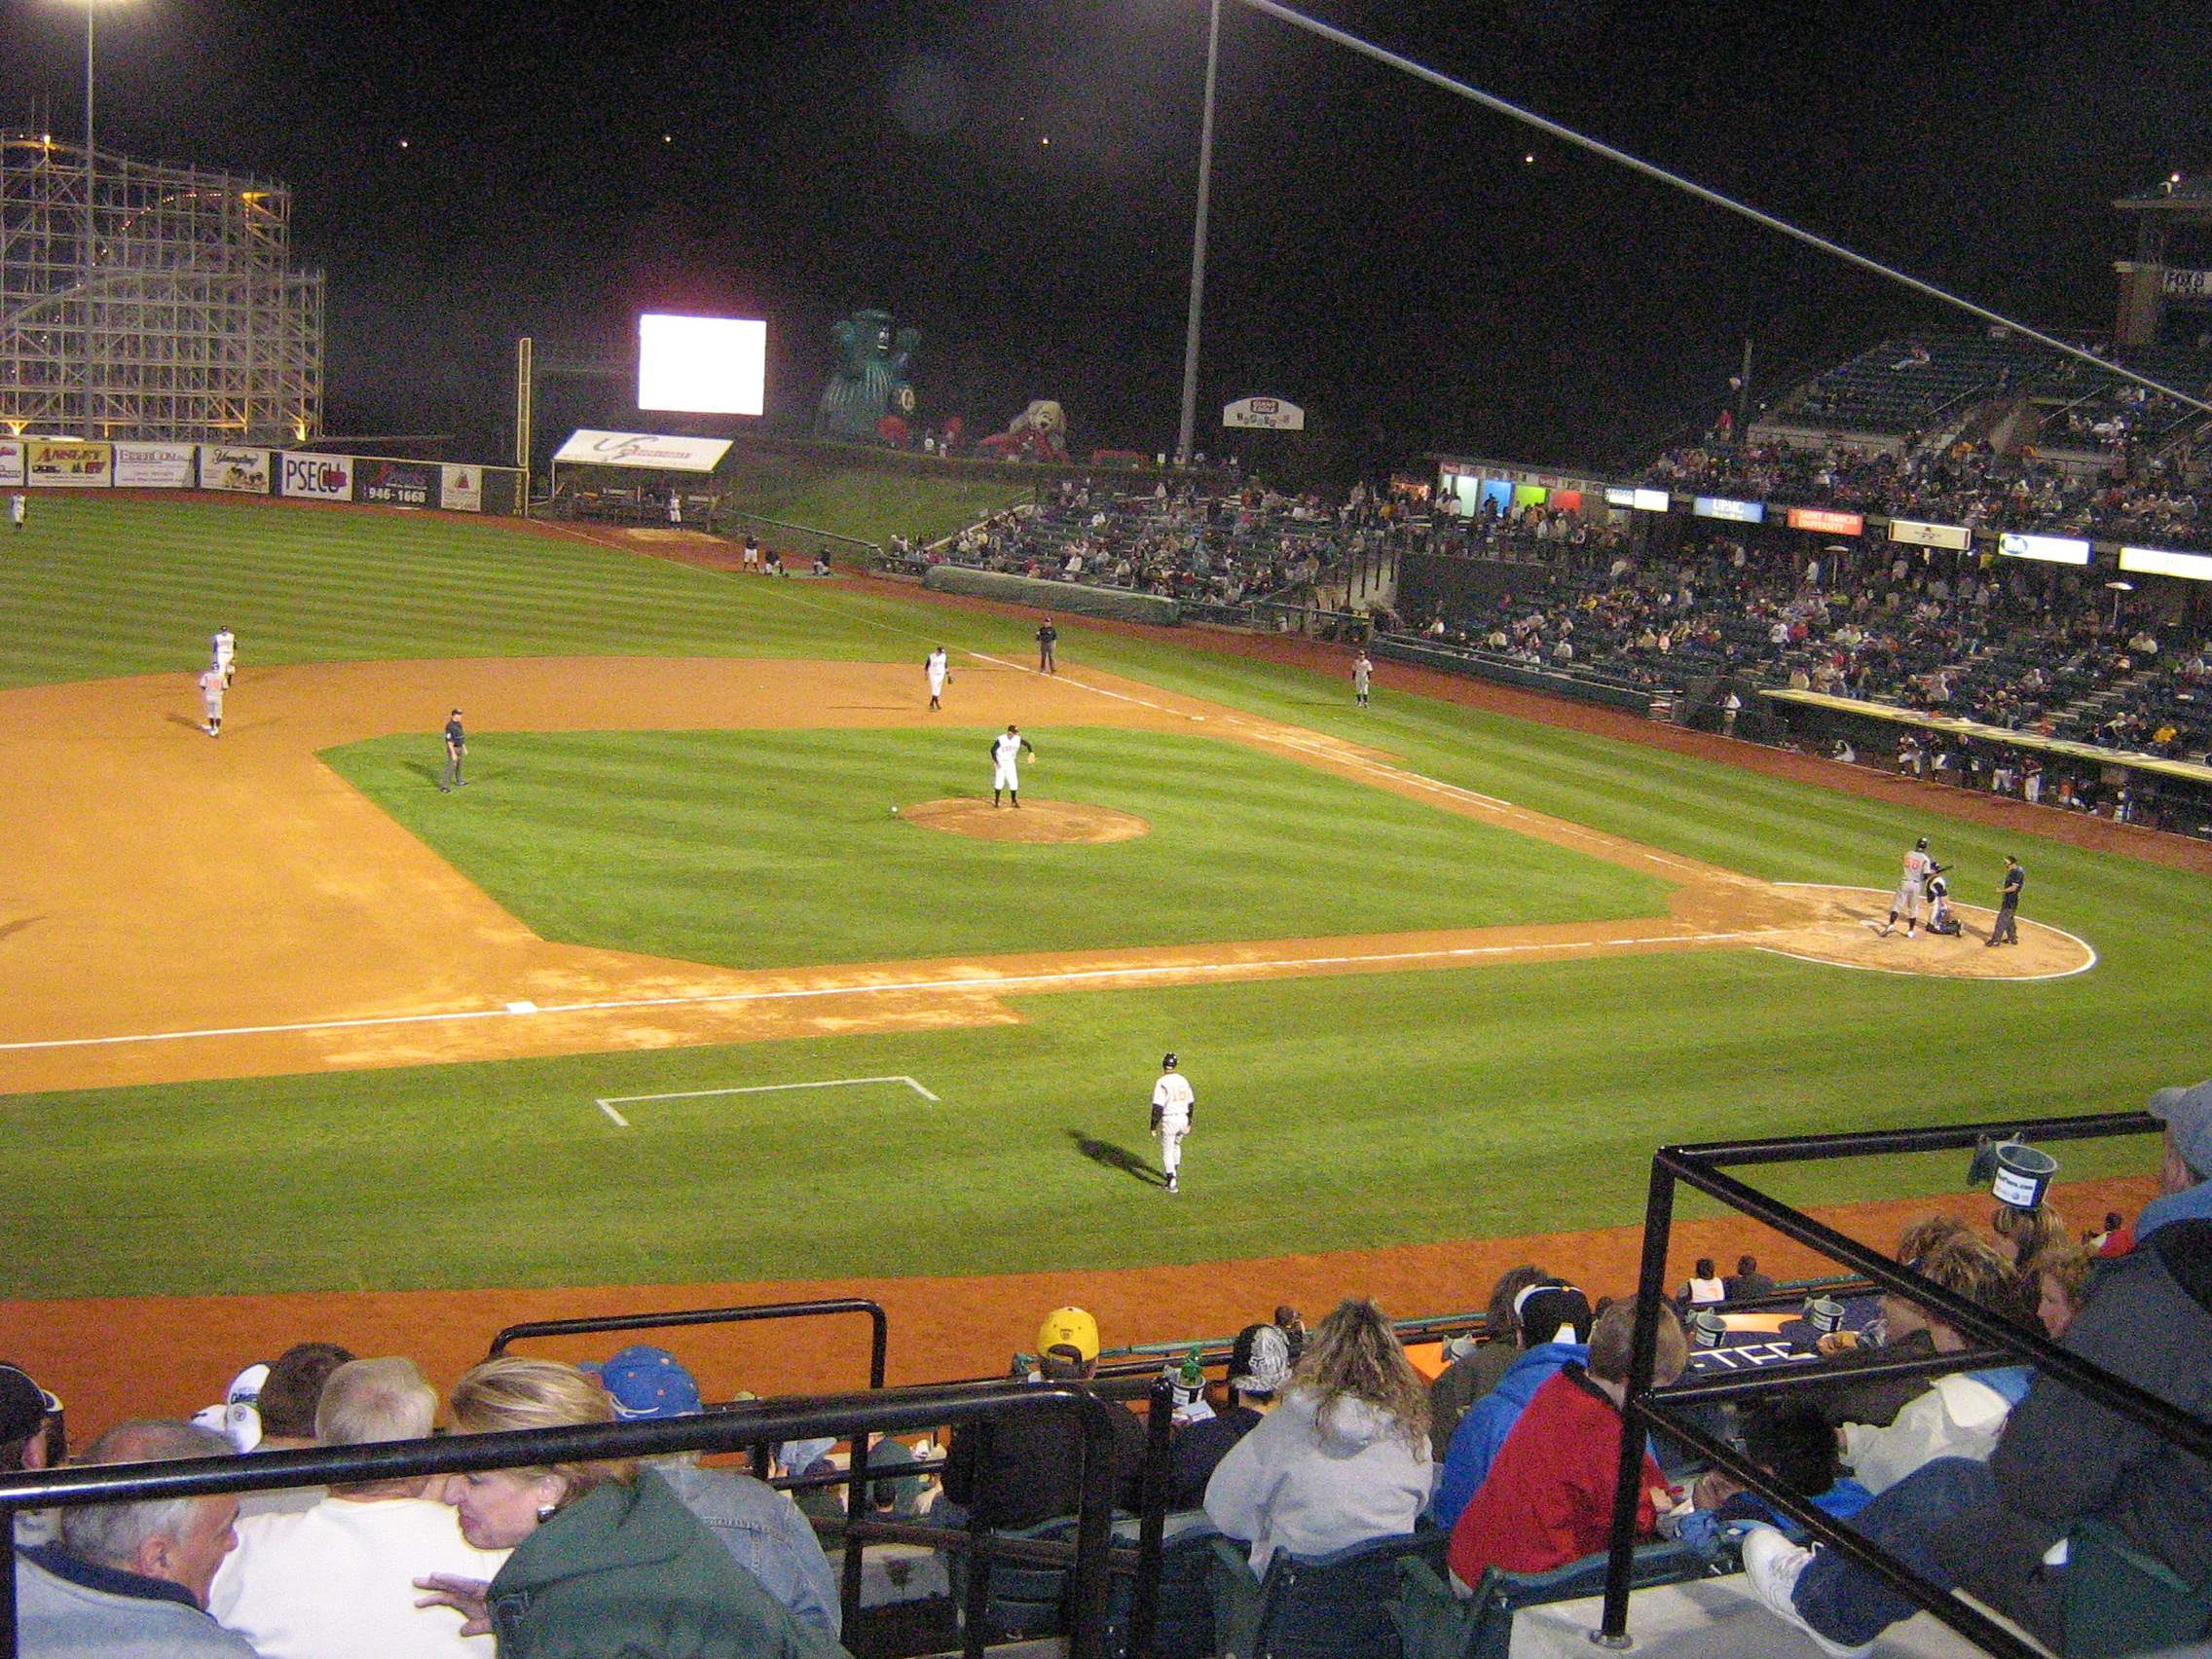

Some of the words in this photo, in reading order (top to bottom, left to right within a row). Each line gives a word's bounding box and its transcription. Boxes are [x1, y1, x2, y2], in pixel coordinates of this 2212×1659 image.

[286, 460, 341, 493] PSECU
[1713, 498, 1745, 514] UPMC
[1797, 519, 1845, 532] UNIVERSITY
[1798, 510, 1824, 521] SAINT
[1825, 512, 1859, 526] FRANCIS
